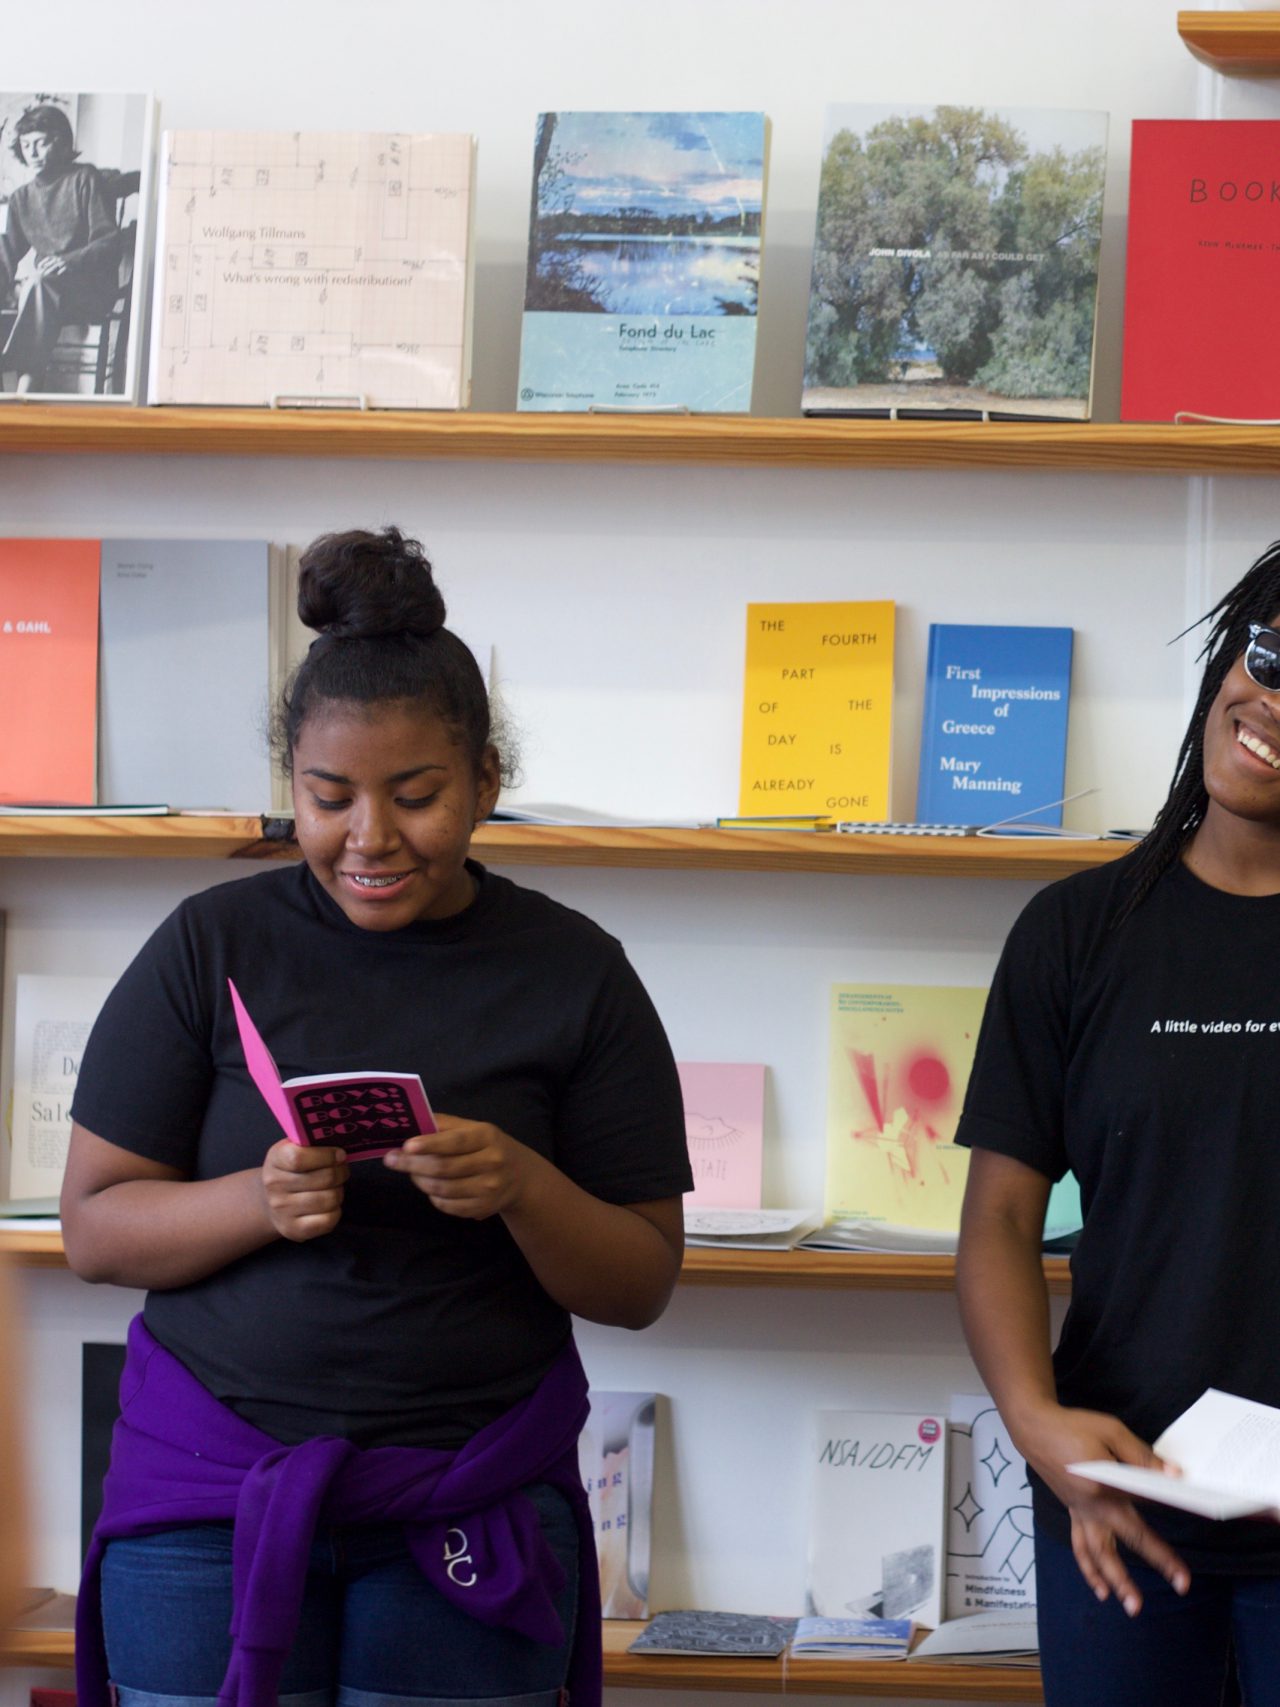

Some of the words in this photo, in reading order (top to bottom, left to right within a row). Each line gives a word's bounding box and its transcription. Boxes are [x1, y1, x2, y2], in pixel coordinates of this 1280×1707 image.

[202, 226, 255, 240] Wolfgang
[259, 226, 306, 239] Tillmans
[869, 248, 895, 257] JOHN
[896, 249, 931, 258] DIVOLA
[951, 251, 969, 259] FAR
[971, 252, 984, 260] AS
[991, 252, 1024, 261] COULD
[1026, 253, 1045, 262] GET
[223, 273, 261, 284] What's
[264, 276, 300, 286] wrong
[304, 273, 328, 284] with
[331, 274, 413, 287] redistribution?
[619, 323, 657, 339] Fond
[663, 324, 683, 339] du
[690, 325, 716, 339] Lac
[16, 621, 51, 634] GAHL
[760, 620, 785, 632] THE
[822, 633, 877, 646] FOURTH
[782, 668, 816, 680] PART
[946, 665, 981, 680] First
[972, 685, 1061, 701] Impressions
[758, 702, 779, 714] OF
[848, 699, 872, 711] THE
[994, 703, 1010, 717] of
[942, 720, 996, 735] Greece
[767, 735, 797, 746] DAY
[830, 744, 842, 755] IS
[940, 757, 981, 773] Mary
[752, 779, 816, 791] ALREADY
[952, 776, 1023, 794] Manning
[826, 796, 869, 808] GONE
[1150, 1020, 1161, 1033] A
[1165, 1020, 1198, 1033] little
[1201, 1021, 1242, 1033] video
[1245, 1020, 1266, 1033] for
[300, 1087, 400, 1109] BOYS!
[305, 1102, 405, 1124] BOYS!
[312, 1117, 411, 1140] BOYS!
[819, 1439, 934, 1472] NSA/DFM
[965, 1584, 1026, 1596] Mindfulness
[965, 1597, 972, 1606] &
